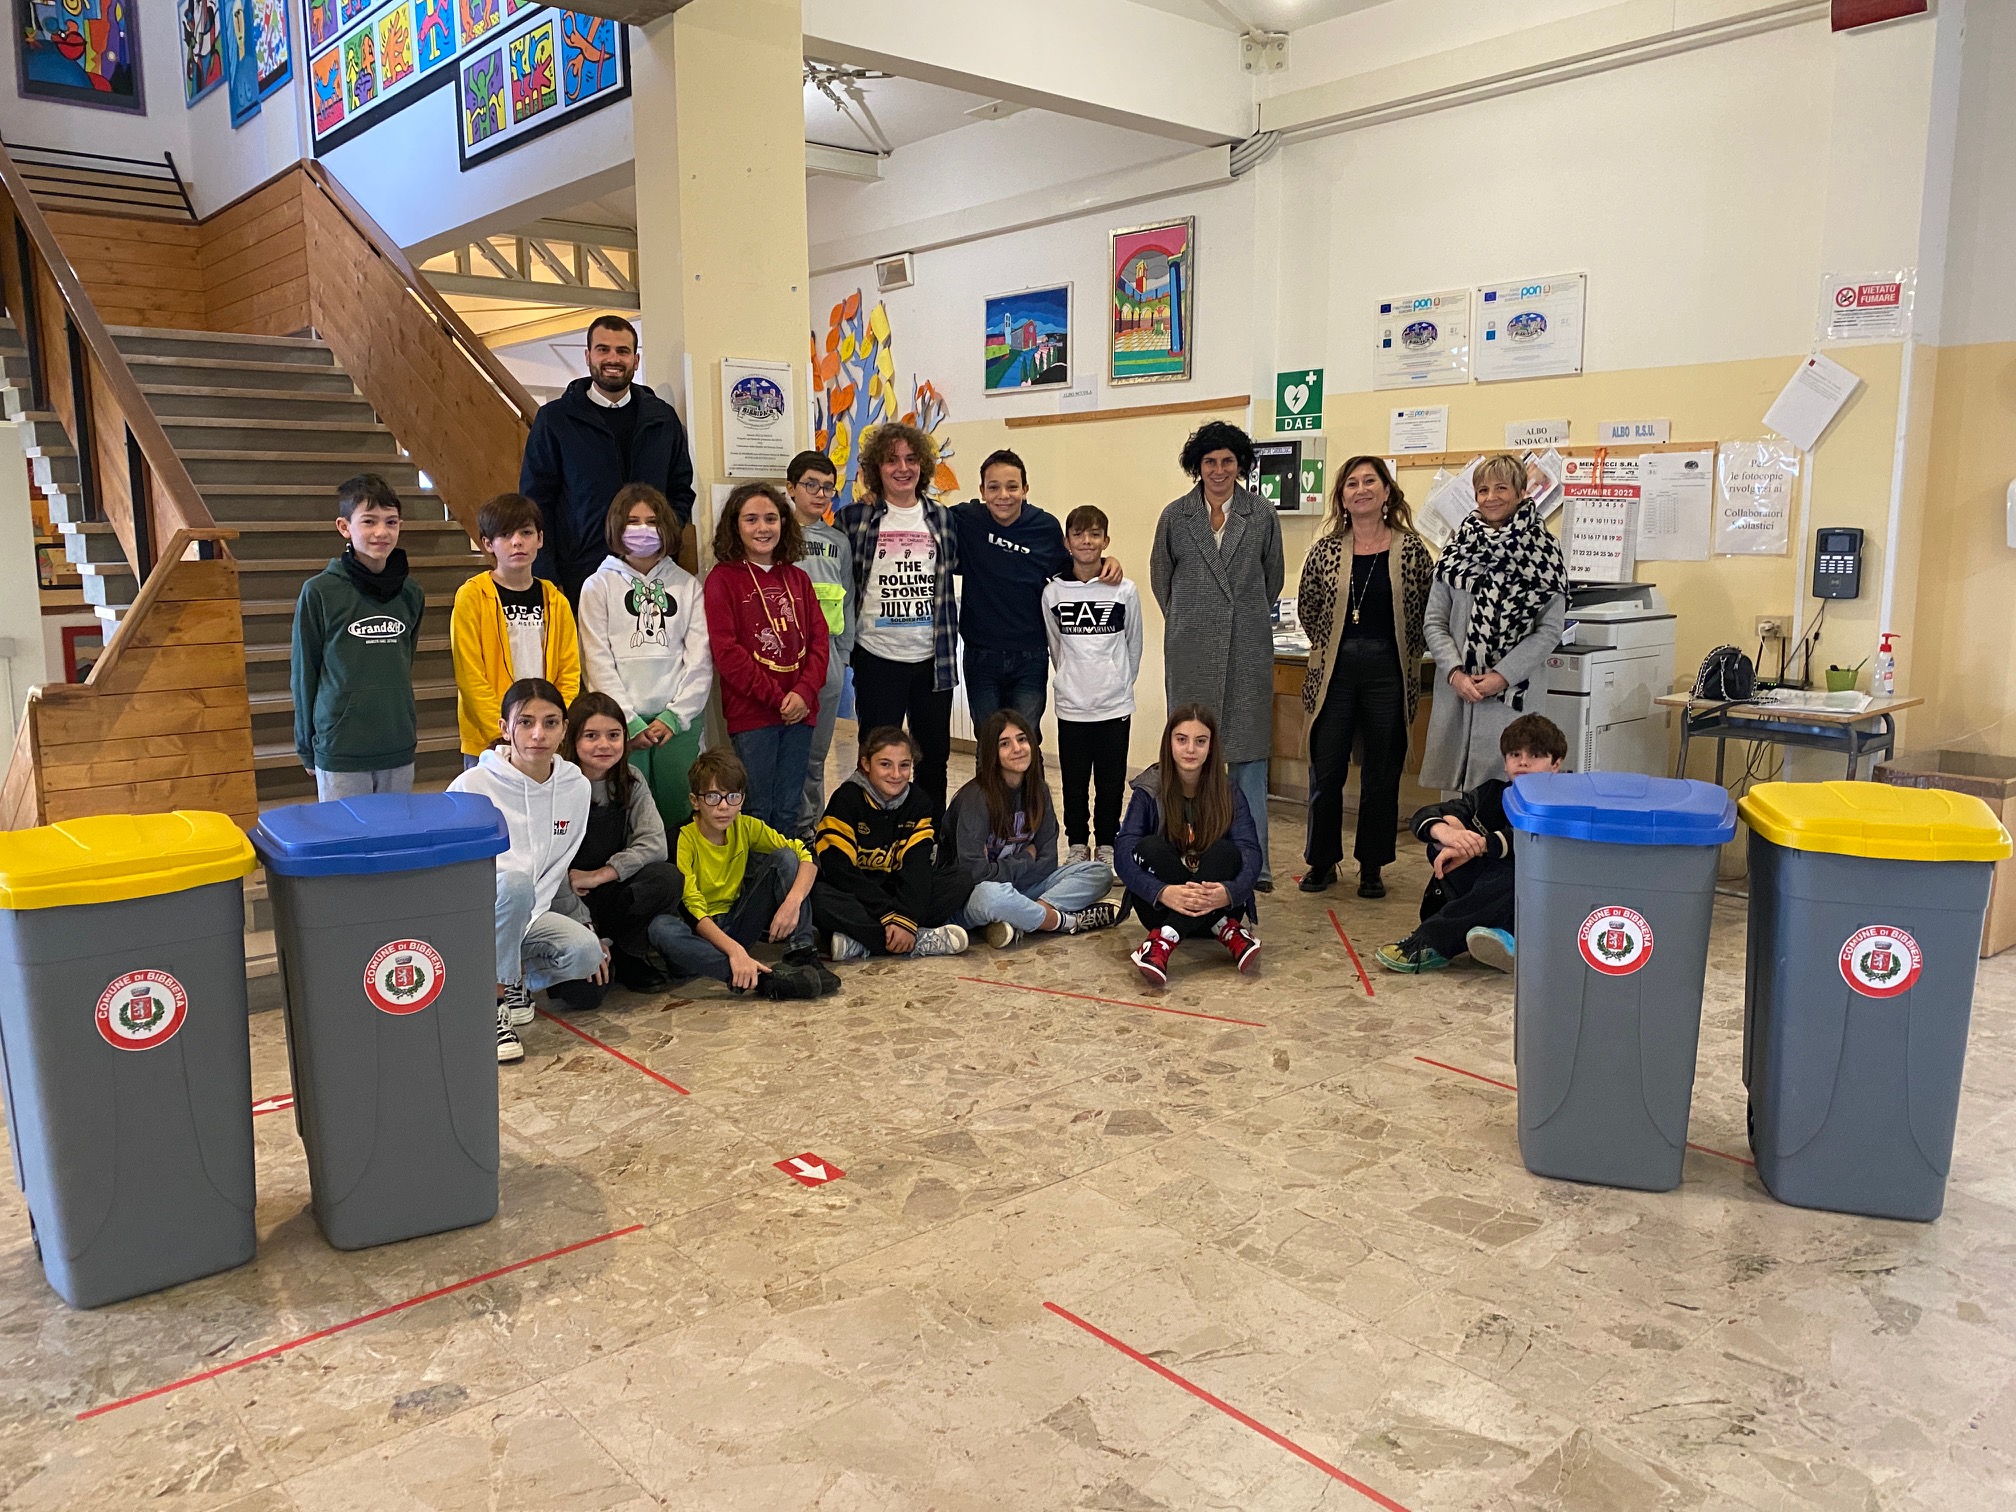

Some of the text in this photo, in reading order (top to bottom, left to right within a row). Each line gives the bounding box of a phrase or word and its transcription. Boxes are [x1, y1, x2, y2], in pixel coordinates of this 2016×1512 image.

[1521, 285, 1542, 300] pon
[1862, 285, 1896, 294] VIETATO
[1413, 298, 1432, 312] pon
[1861, 294, 1896, 304] FUMARE
[1284, 417, 1313, 430] DAE
[1526, 427, 1548, 436] ALBO
[1612, 424, 1655, 438] ALBO R.S.U.
[1514, 436, 1560, 446] SINDACALE
[1731, 472, 1783, 482] le fotocopie
[1614, 489, 1634, 497] 2022
[1774, 484, 1782, 493] ai
[1724, 508, 1783, 518] Collaboratori
[895, 561, 922, 572] THE
[879, 575, 935, 586] ROLLING
[881, 586, 935, 598] STONES
[502, 604, 543, 620] UES
[880, 601, 911, 617] JULY
[1058, 602, 1116, 626] EA7
[774, 617, 788, 632] H
[1580, 909, 1610, 940] COMUNE
[1623, 910, 1652, 947] BIBBIENA
[1842, 928, 1877, 960] COMUNE
[1891, 930, 1920, 969] BIBBIENA
[366, 945, 396, 984] COMUNE
[409, 942, 443, 976] BIBBIENA
[98, 976, 131, 1018] COMUNE
[147, 972, 184, 1008] BIBBIENA
